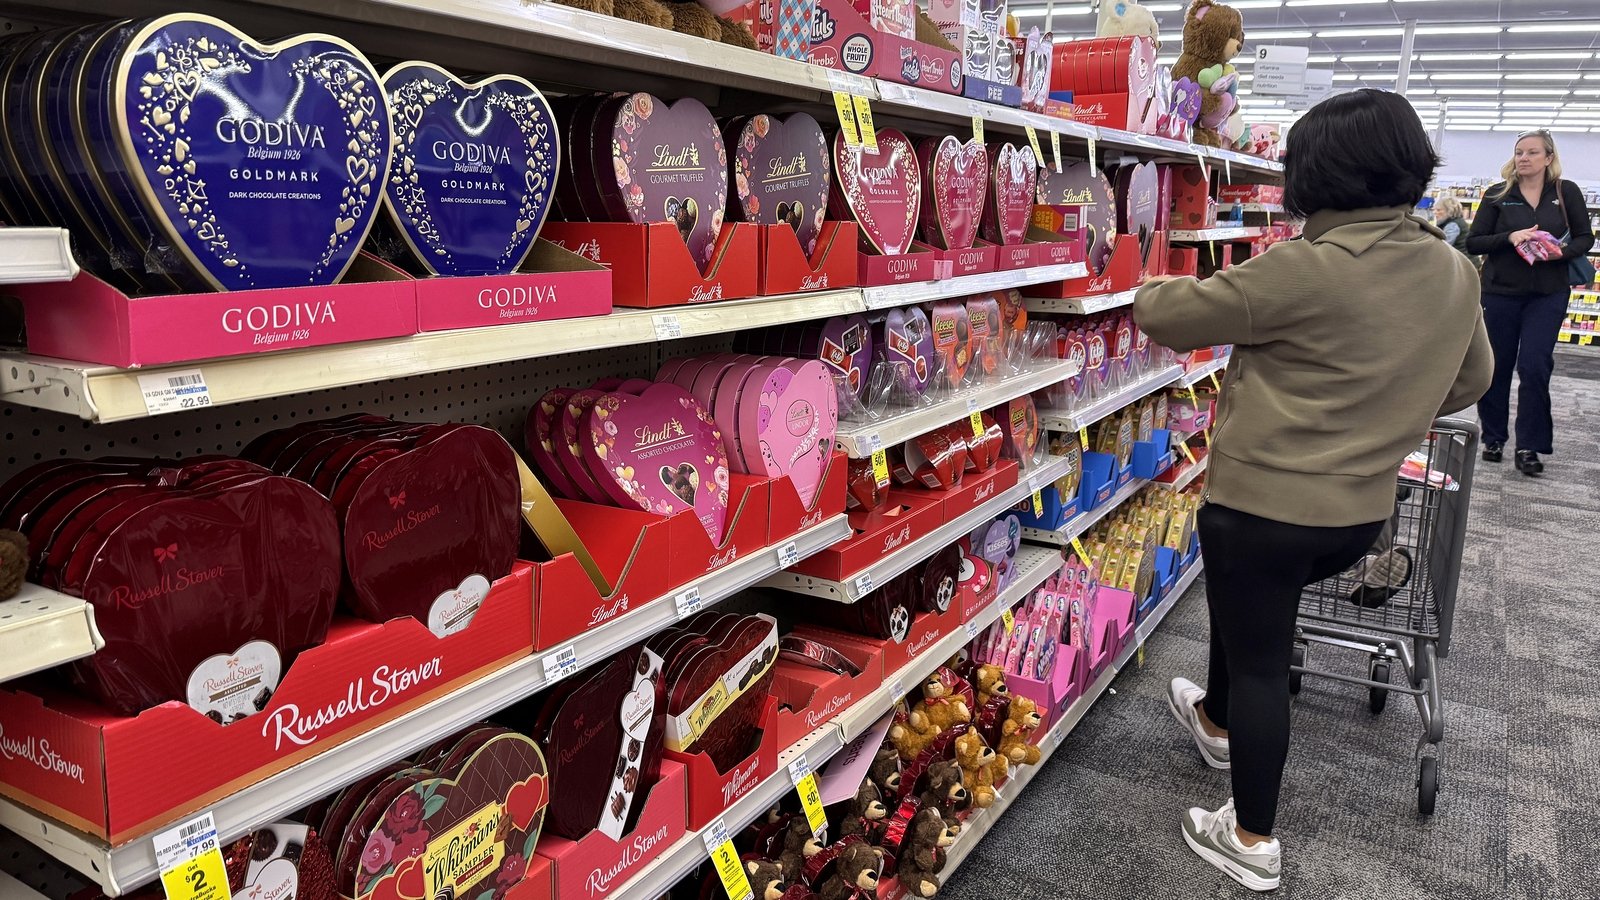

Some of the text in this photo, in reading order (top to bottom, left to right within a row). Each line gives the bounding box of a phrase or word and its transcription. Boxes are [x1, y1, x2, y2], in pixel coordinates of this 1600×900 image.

[807, 53, 835, 66] Throbs
[846, 53, 868, 61] FRUIT!
[1259, 48, 1267, 59] 9
[216, 117, 325, 149] GODIVA
[248, 146, 301, 160] Belgium 1926
[433, 141, 511, 165] GODIVA
[651, 144, 690, 167] Lindt
[230, 169, 319, 182] GOLDMARK
[454, 162, 493, 174] Belgium 1926
[767, 156, 798, 178] Lindt
[864, 167, 898, 180] GODIVA
[441, 180, 505, 191] GOLDMARK
[650, 172, 704, 184] GOURMET TRUFFLES
[764, 178, 810, 193] GOURMET TRUFFLES
[228, 191, 321, 200] DARK CHOCOLATE CREATIONS
[1063, 189, 1085, 202] Lindt
[1220, 189, 1251, 197] Sweethearts
[959, 251, 984, 266] GODIVA
[1011, 248, 1030, 261] GODIVA
[1050, 246, 1071, 258] GODIVA
[887, 259, 918, 273] GODIVA
[801, 275, 822, 290] Lindt
[1087, 279, 1107, 292] Lindt
[478, 285, 557, 308] GODIVA
[689, 285, 716, 303] Lindt
[222, 301, 336, 333] GODIVA
[500, 306, 538, 318] Belgium 1926
[935, 316, 955, 332] Reese's
[253, 329, 310, 345] Belgium 1926
[180, 396, 210, 408] $22.99
[634, 423, 672, 447] Lindt
[636, 439, 695, 461] ASSORTED CHOCOLATES
[974, 480, 991, 502] Lindt
[362, 504, 441, 551] Russell Stover
[798, 511, 818, 530] Lindt
[882, 531, 904, 552] Lindt
[987, 539, 1008, 553] KISSES
[706, 549, 730, 571] Lindt
[108, 565, 224, 611] Russell Stover
[439, 593, 479, 621] Russell Stover
[587, 599, 621, 627] Lindt
[905, 629, 940, 658] Russell Stover
[203, 664, 264, 692] Russell Stover
[224, 683, 247, 695] ASSORTED
[262, 656, 443, 751] Russell Stover
[804, 692, 851, 728] Russell Stover
[624, 704, 640, 723] Russell
[560, 721, 605, 766] Russell Stover
[39, 738, 85, 784] Stover
[722, 756, 760, 808] Whitman's
[735, 776, 759, 799] SAMPLER
[163, 846, 171, 854] RED
[189, 839, 215, 858] $7.99
[426, 808, 501, 895] Whitman's
[187, 864, 199, 872] Get
[452, 845, 494, 880] SAMPLER
[585, 852, 634, 898] Russell
[632, 824, 669, 861] Stover
[185, 869, 208, 893] $2
[263, 876, 292, 900] Stover
[190, 885, 217, 900] traBucks
